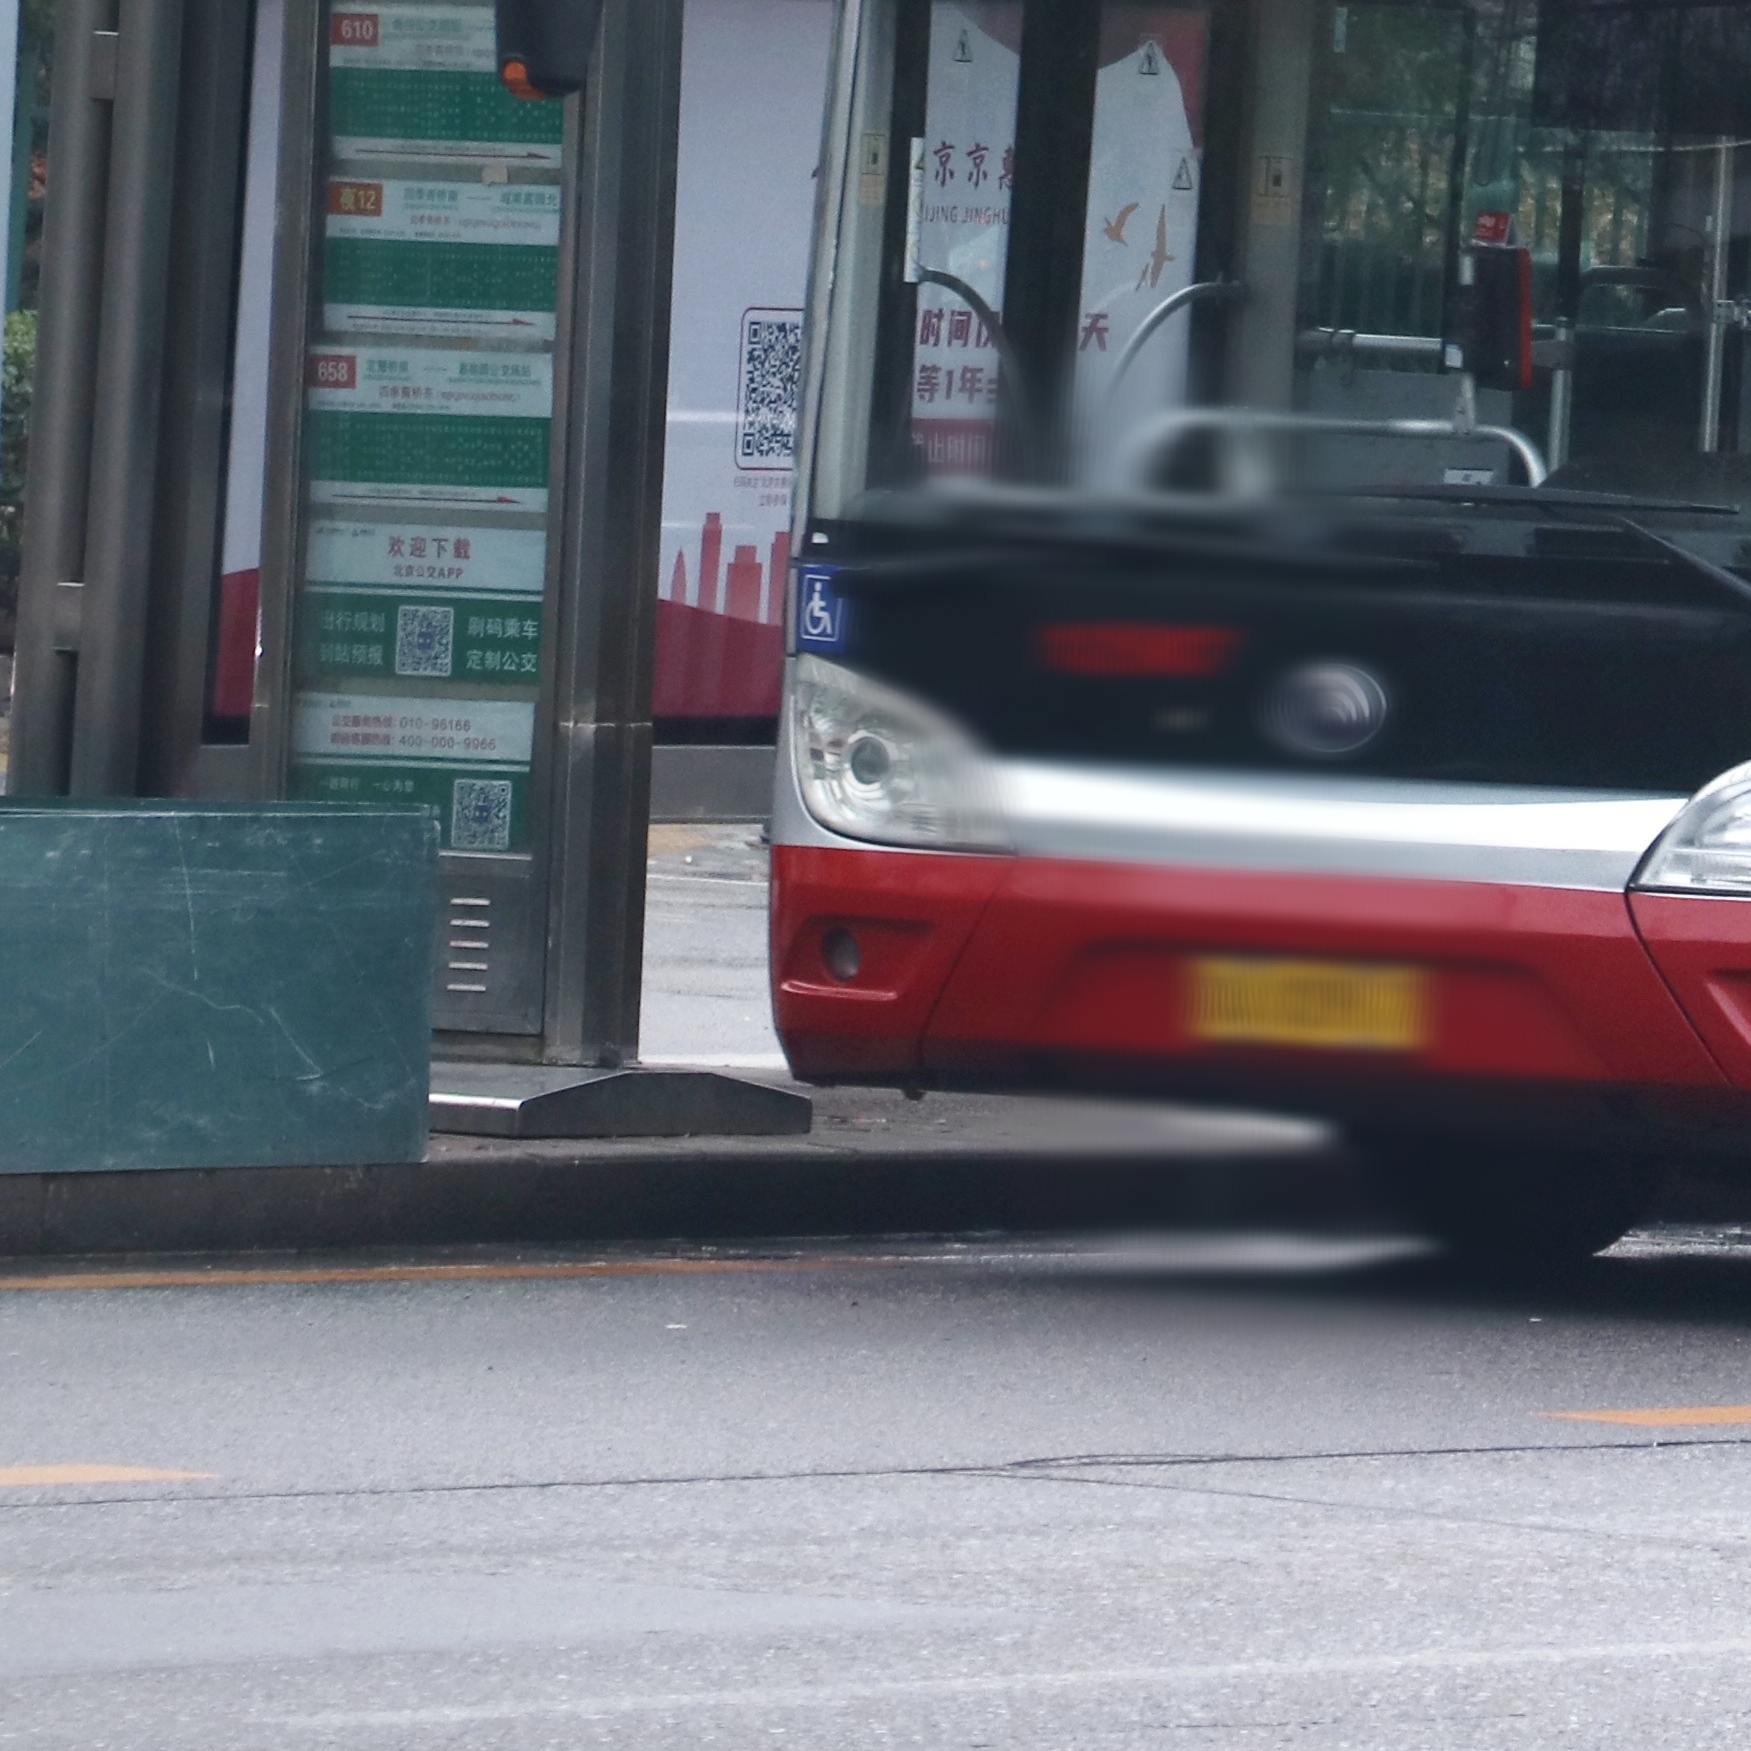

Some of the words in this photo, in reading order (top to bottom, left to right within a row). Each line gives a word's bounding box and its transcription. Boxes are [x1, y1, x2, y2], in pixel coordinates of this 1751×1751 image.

[341, 19, 374, 40] 610
[317, 361, 349, 382] 658
[388, 535, 472, 560] 欢迎下载
[393, 564, 464, 580] 北京公交APP
[467, 616, 539, 641] 刷码乘车
[465, 649, 538, 673] 定制公交
